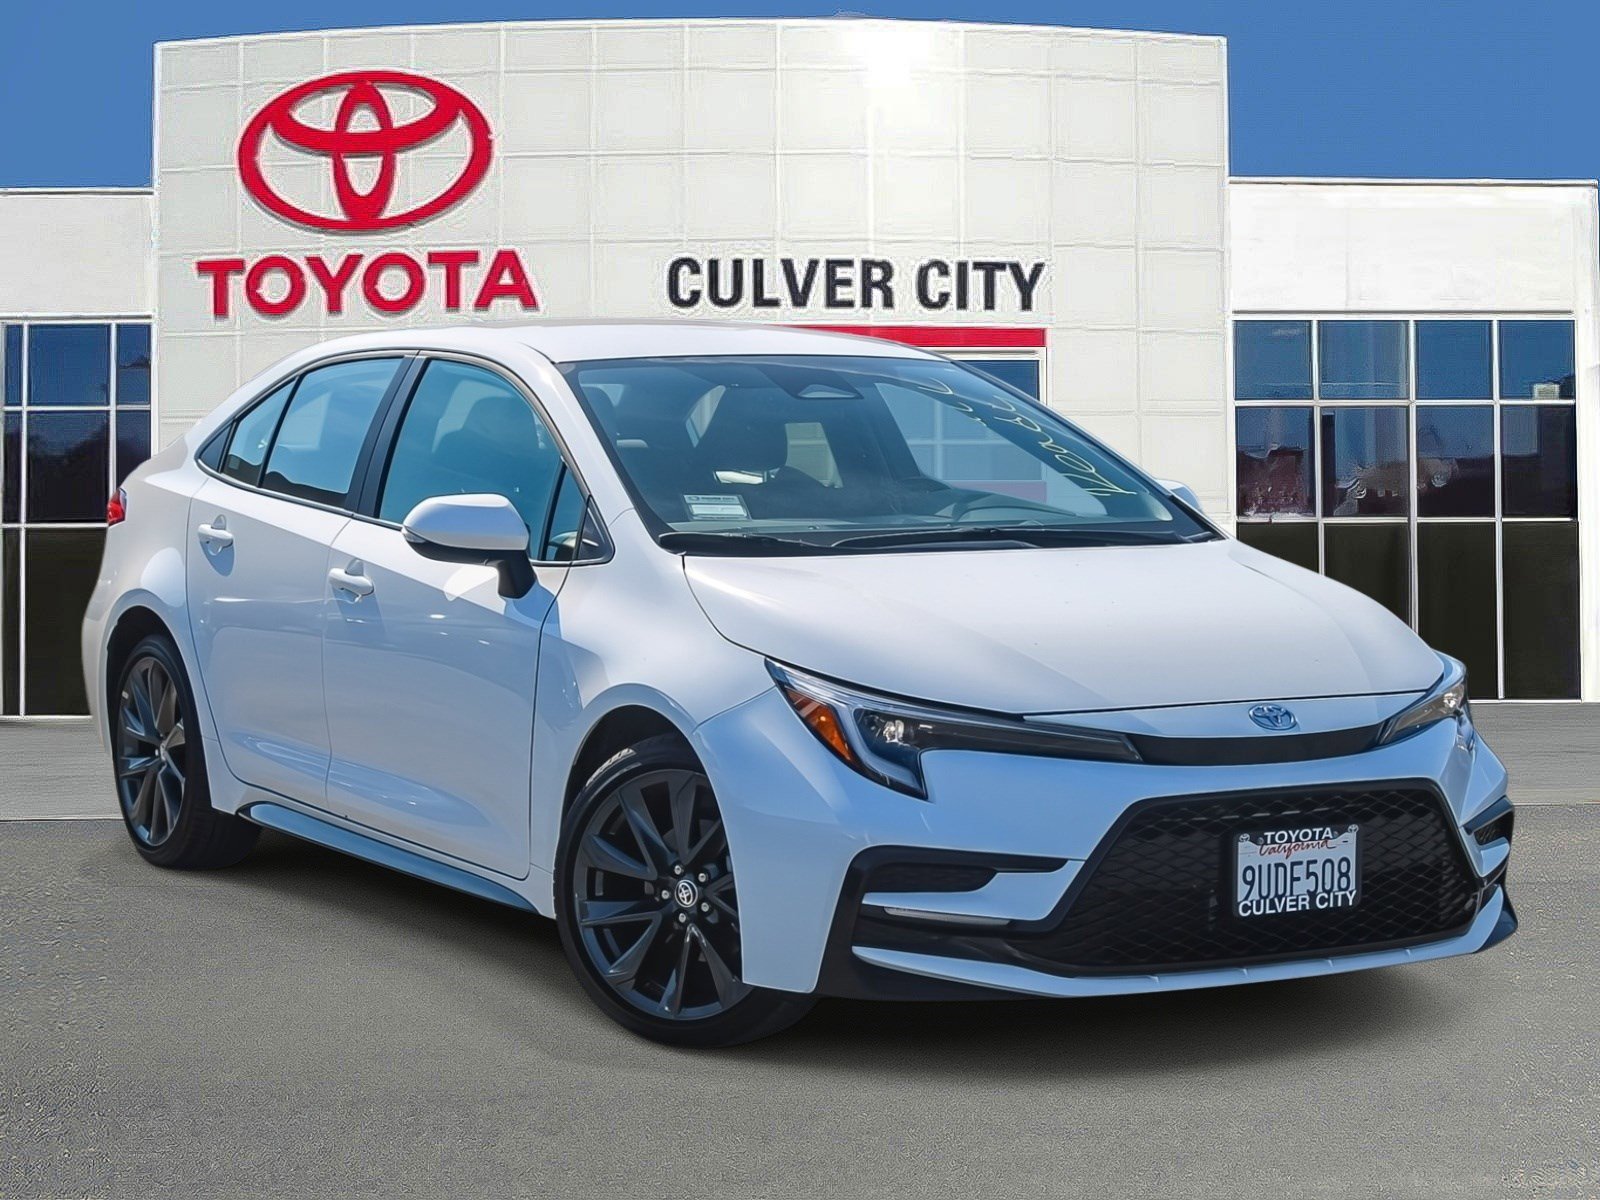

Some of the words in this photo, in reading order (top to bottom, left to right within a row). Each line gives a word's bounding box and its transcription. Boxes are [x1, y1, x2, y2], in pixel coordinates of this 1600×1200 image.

[197, 249, 538, 317] TOYOTA
[669, 258, 893, 308] CULVER
[918, 260, 1045, 310] CITY
[1264, 827, 1333, 844] TOYOTA
[1259, 839, 1336, 860] California
[1238, 894, 1310, 917] CULVER
[1316, 890, 1357, 909] CITY
